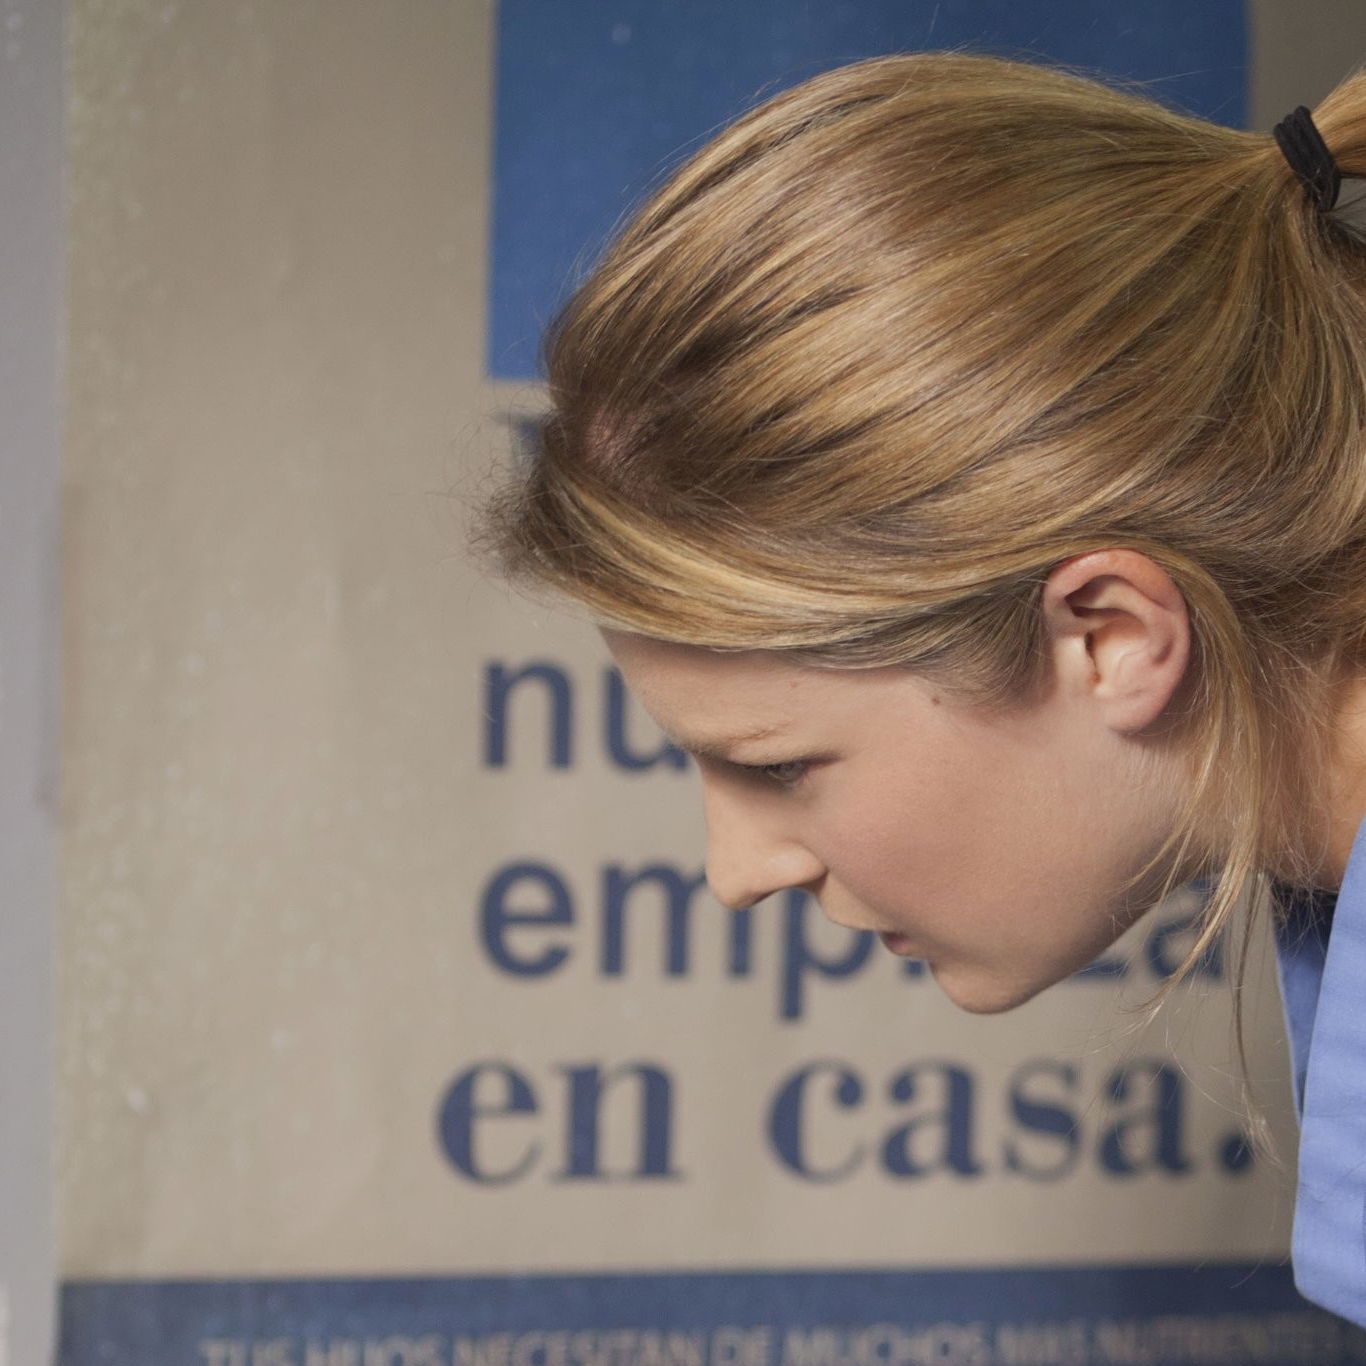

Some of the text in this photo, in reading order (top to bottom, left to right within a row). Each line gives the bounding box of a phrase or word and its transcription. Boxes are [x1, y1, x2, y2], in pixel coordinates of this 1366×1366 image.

[477, 652, 690, 775] nu
[475, 856, 1223, 1022] empa
[432, 1052, 1257, 1186] en casa.
